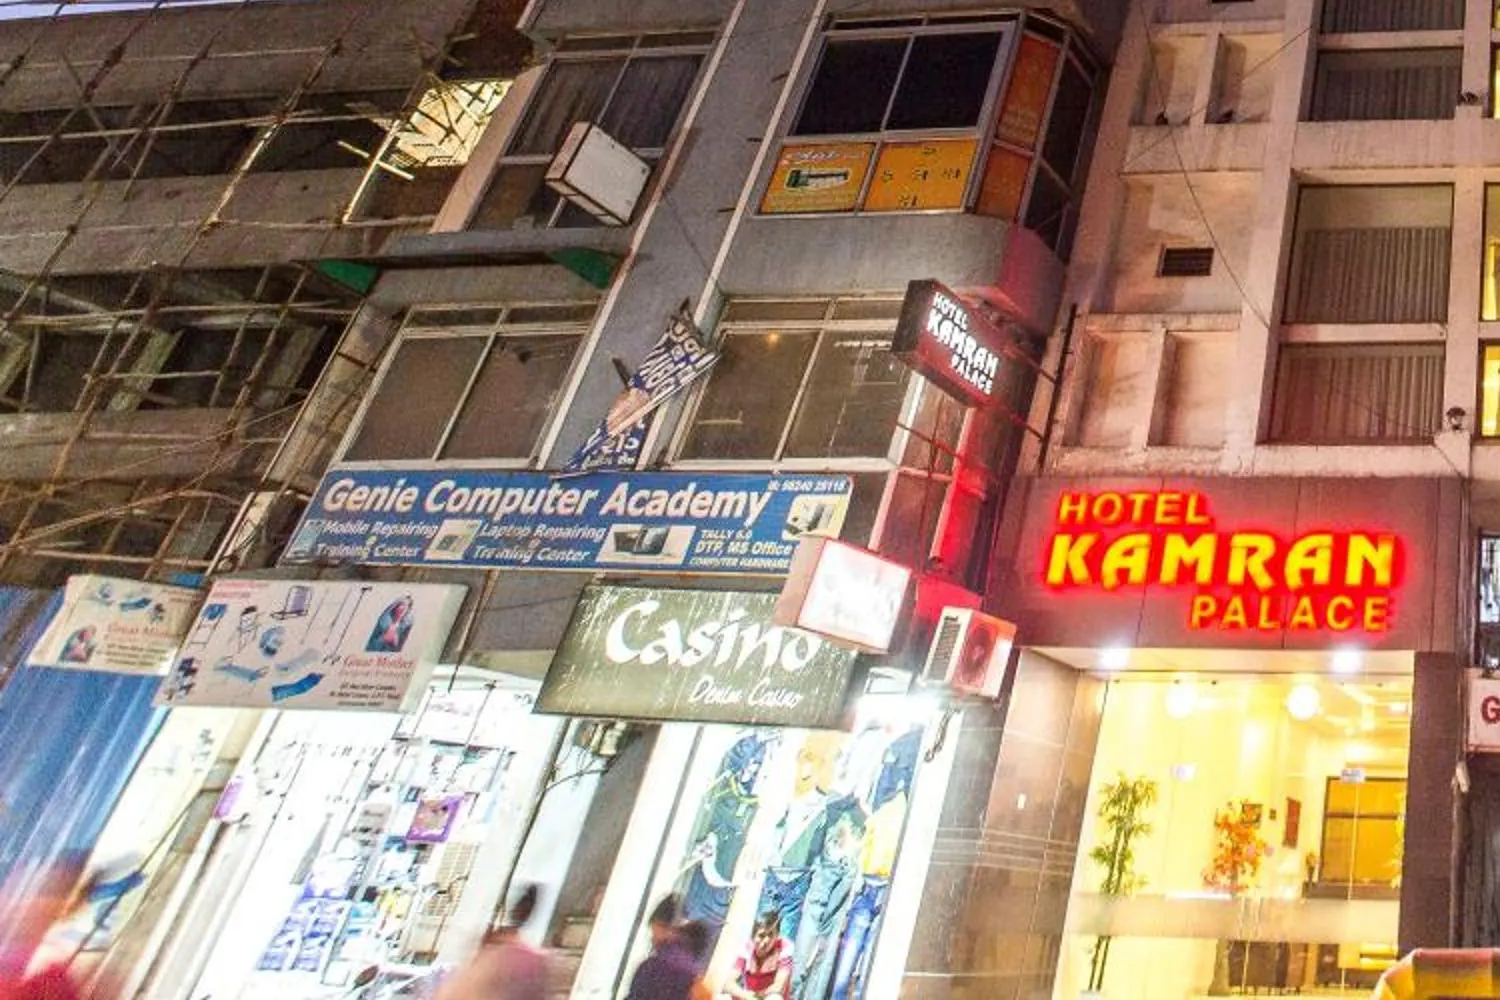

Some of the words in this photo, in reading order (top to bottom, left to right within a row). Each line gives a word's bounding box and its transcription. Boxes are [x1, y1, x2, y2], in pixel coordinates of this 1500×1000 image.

[932, 291, 968, 330] HOTEL
[927, 308, 998, 378] KAMRAN
[950, 355, 992, 395] PALACE
[324, 478, 419, 512] Genie
[425, 479, 598, 519] Computer
[600, 481, 771, 527] Academy
[1057, 492, 1210, 525] HOTEL
[323, 519, 369, 534] Mobile
[372, 520, 439, 539] Repairing
[479, 522, 532, 539] Laptop
[533, 524, 606, 543] Repairing
[315, 543, 372, 560] Training
[374, 543, 420, 558] Center
[473, 545, 533, 563] Training
[536, 547, 590, 561] Center
[728, 542, 750, 555] MS
[751, 541, 794, 556] Office
[1045, 532, 1396, 590] KAMRAN
[1189, 595, 1390, 631] PALACE
[606, 599, 822, 672] Casino
